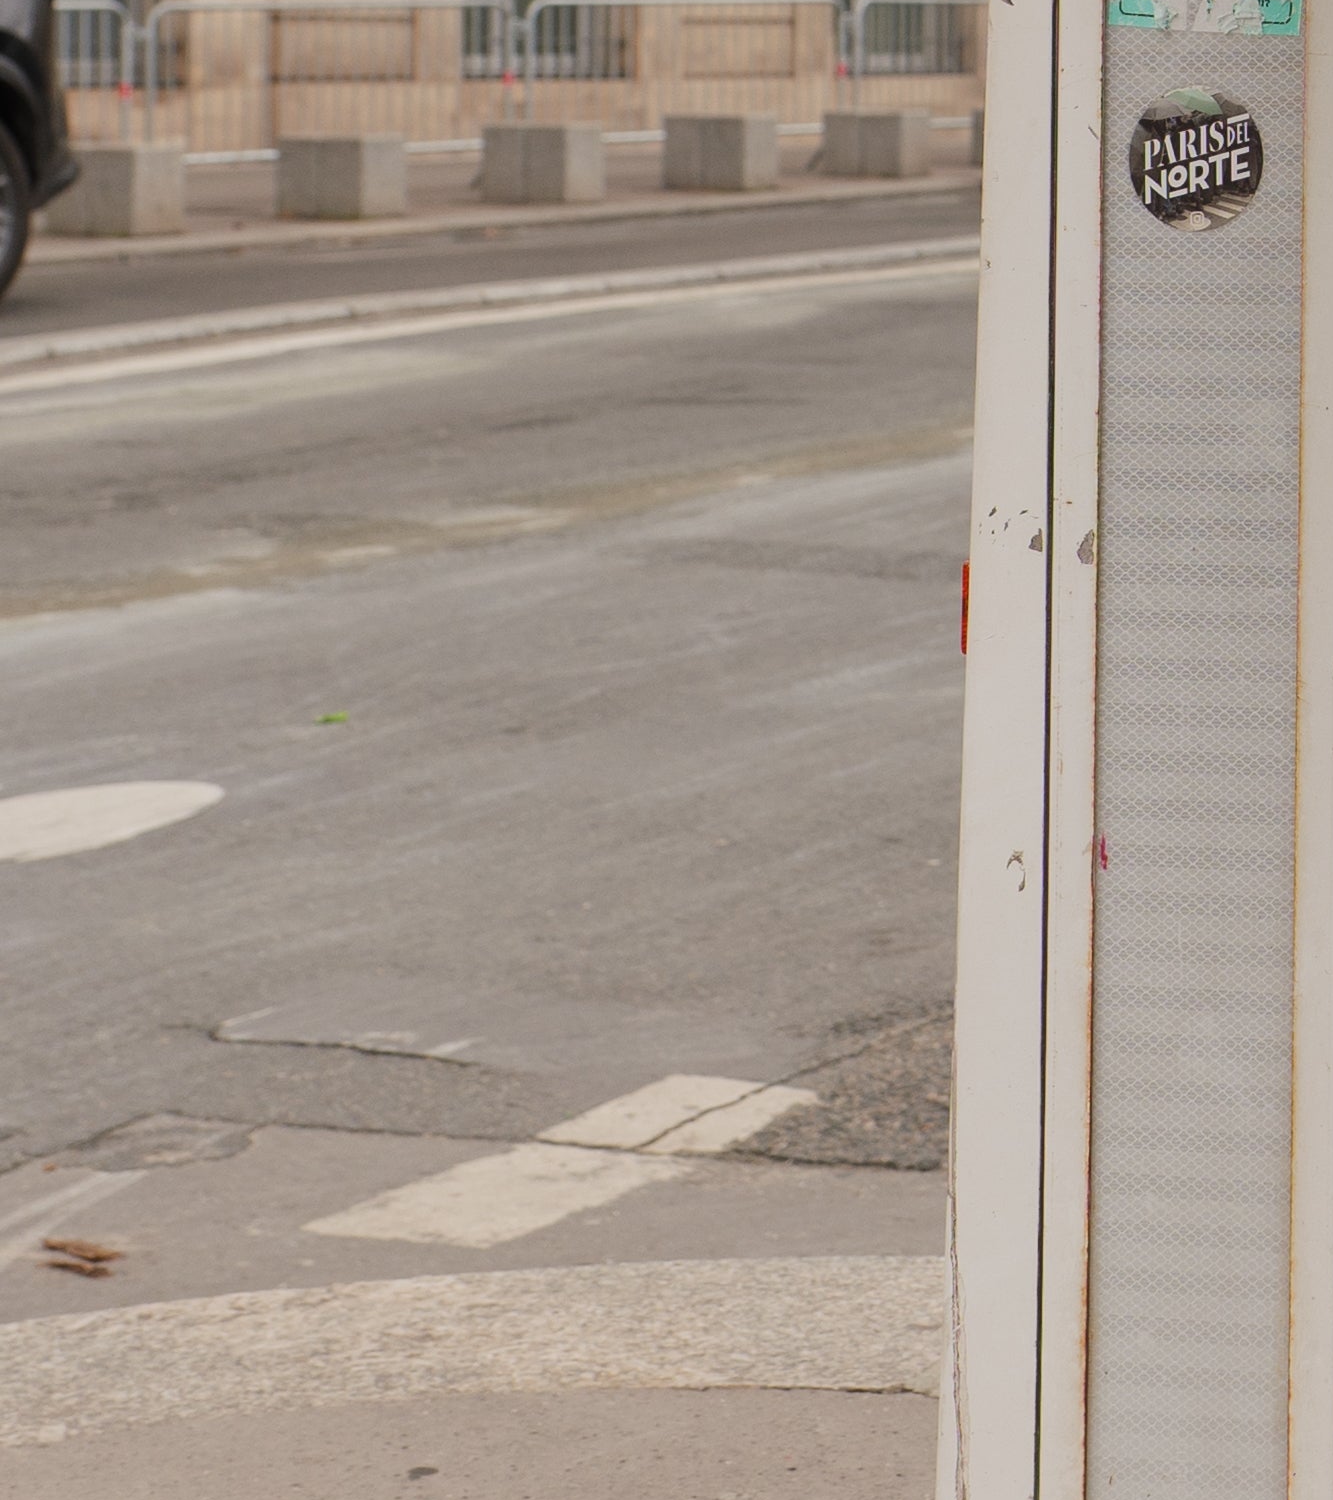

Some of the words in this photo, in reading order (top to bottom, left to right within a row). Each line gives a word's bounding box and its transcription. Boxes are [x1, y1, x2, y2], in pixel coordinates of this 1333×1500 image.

[1143, 120, 1225, 171] PARIS
[1226, 120, 1251, 148] DEL
[1144, 146, 1251, 205] NORTE
